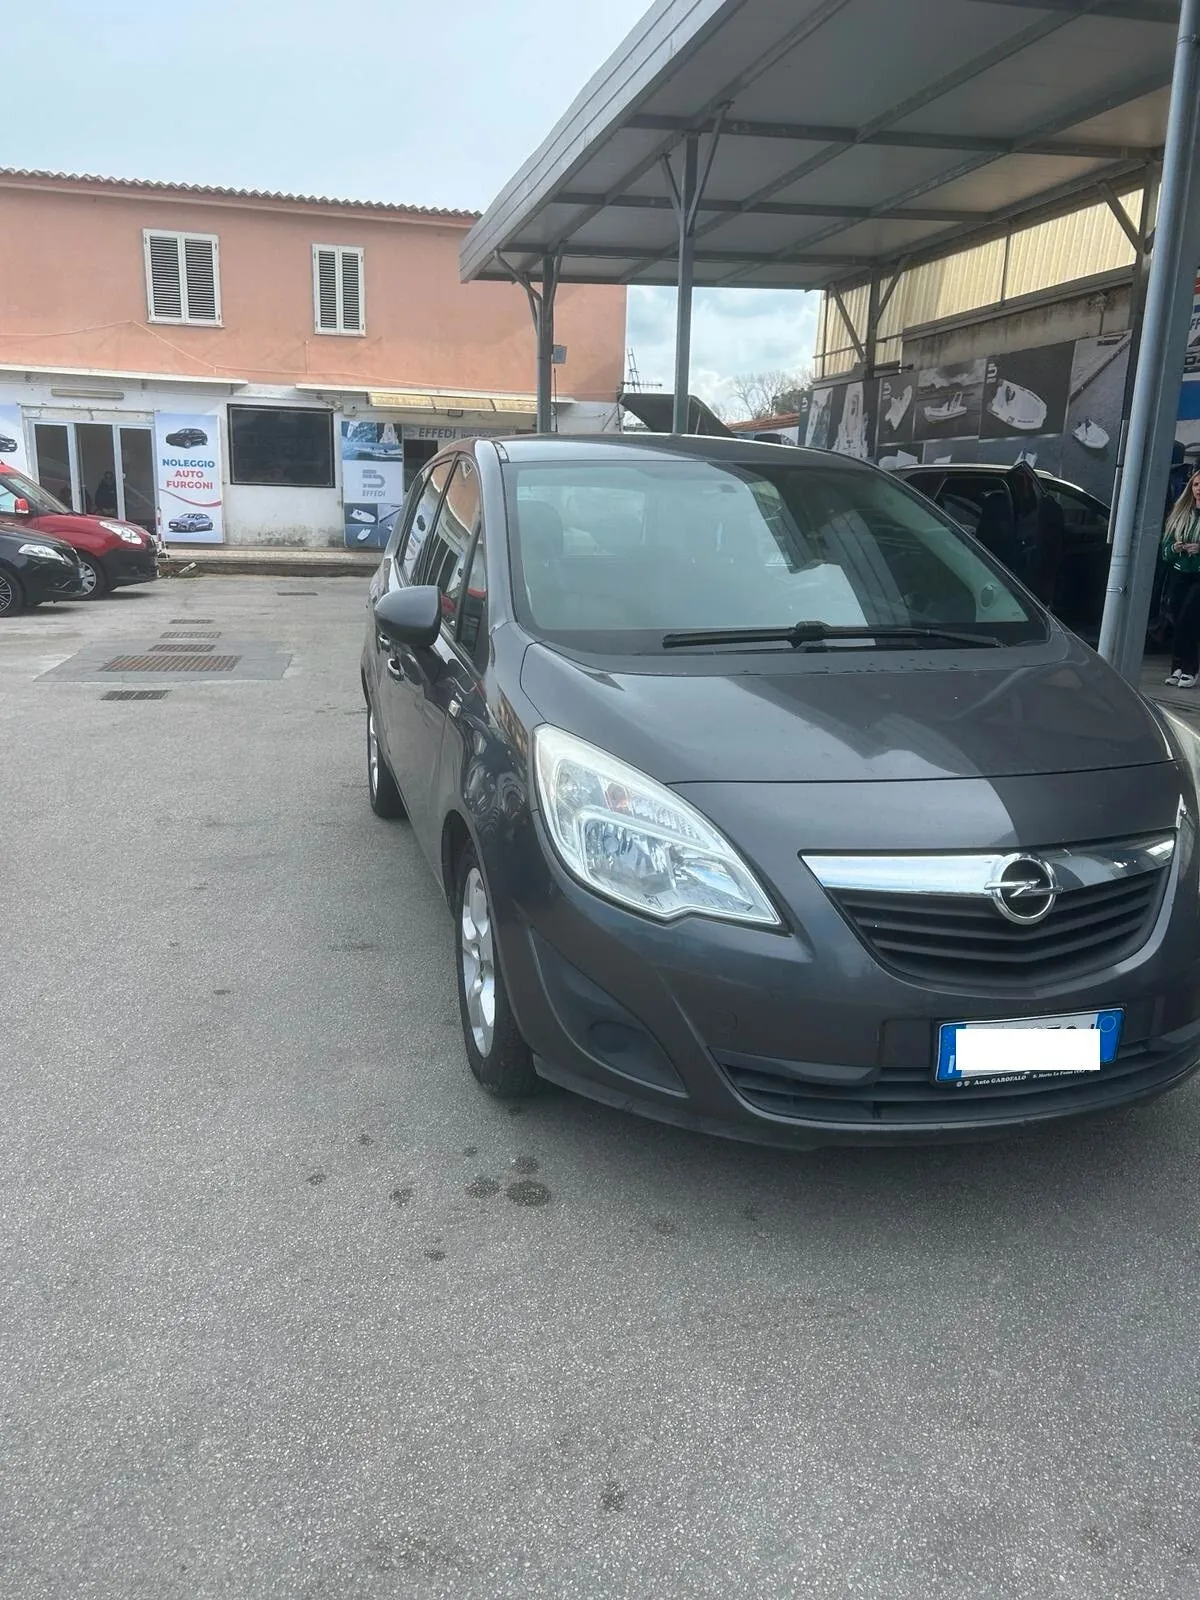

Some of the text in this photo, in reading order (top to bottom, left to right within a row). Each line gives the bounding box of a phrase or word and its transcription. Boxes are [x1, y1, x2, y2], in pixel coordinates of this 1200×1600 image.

[419, 427, 457, 439] EFFEDI
[162, 458, 216, 468] NOLEGGIO
[175, 469, 204, 479] AUTO
[166, 480, 213, 490] FURGONI
[362, 489, 386, 497] EFFEDI
[991, 1075, 1027, 1084] GAROFALO
